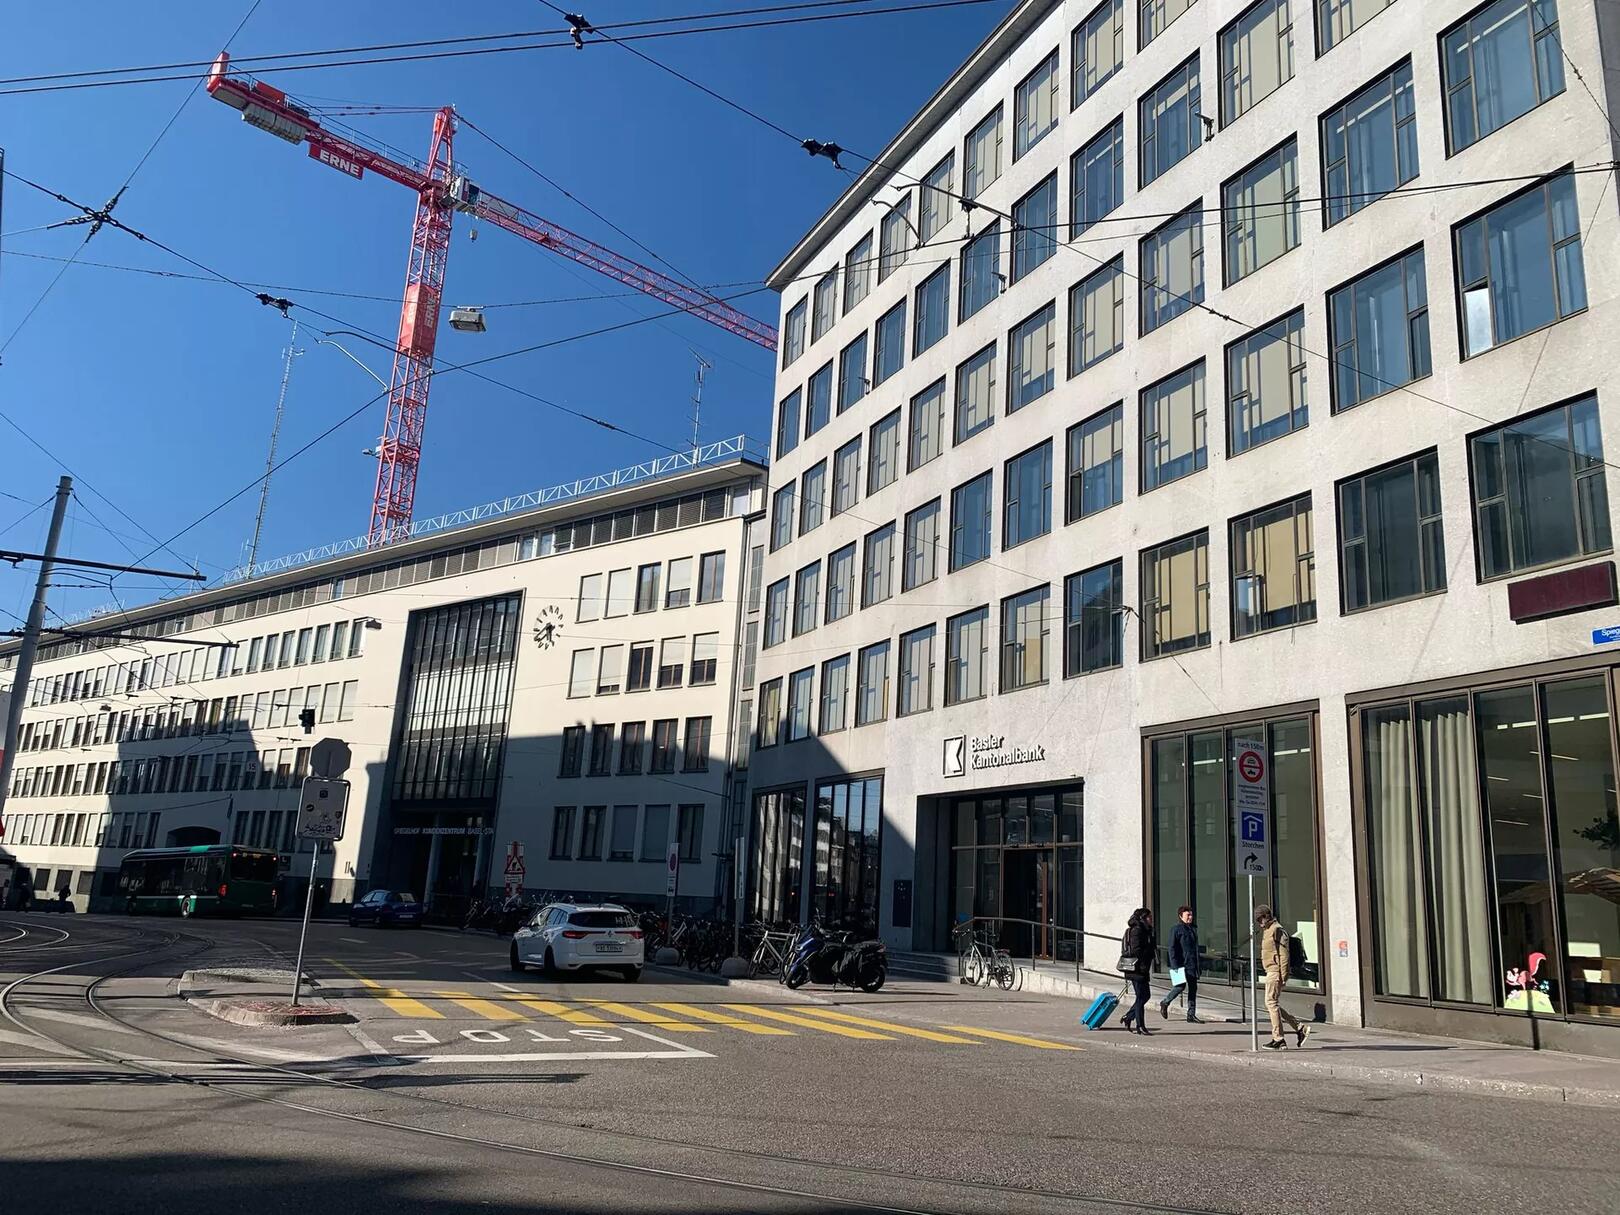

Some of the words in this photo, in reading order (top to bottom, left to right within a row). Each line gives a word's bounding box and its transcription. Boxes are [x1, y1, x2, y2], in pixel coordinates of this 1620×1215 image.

[320, 149, 360, 176] ERNE
[971, 735, 1005, 752] Basler
[971, 744, 1046, 769] Kantonalbank
[1249, 820, 1257, 838] P
[1241, 841, 1264, 849] Storchen
[391, 1028, 624, 1044] STOP
